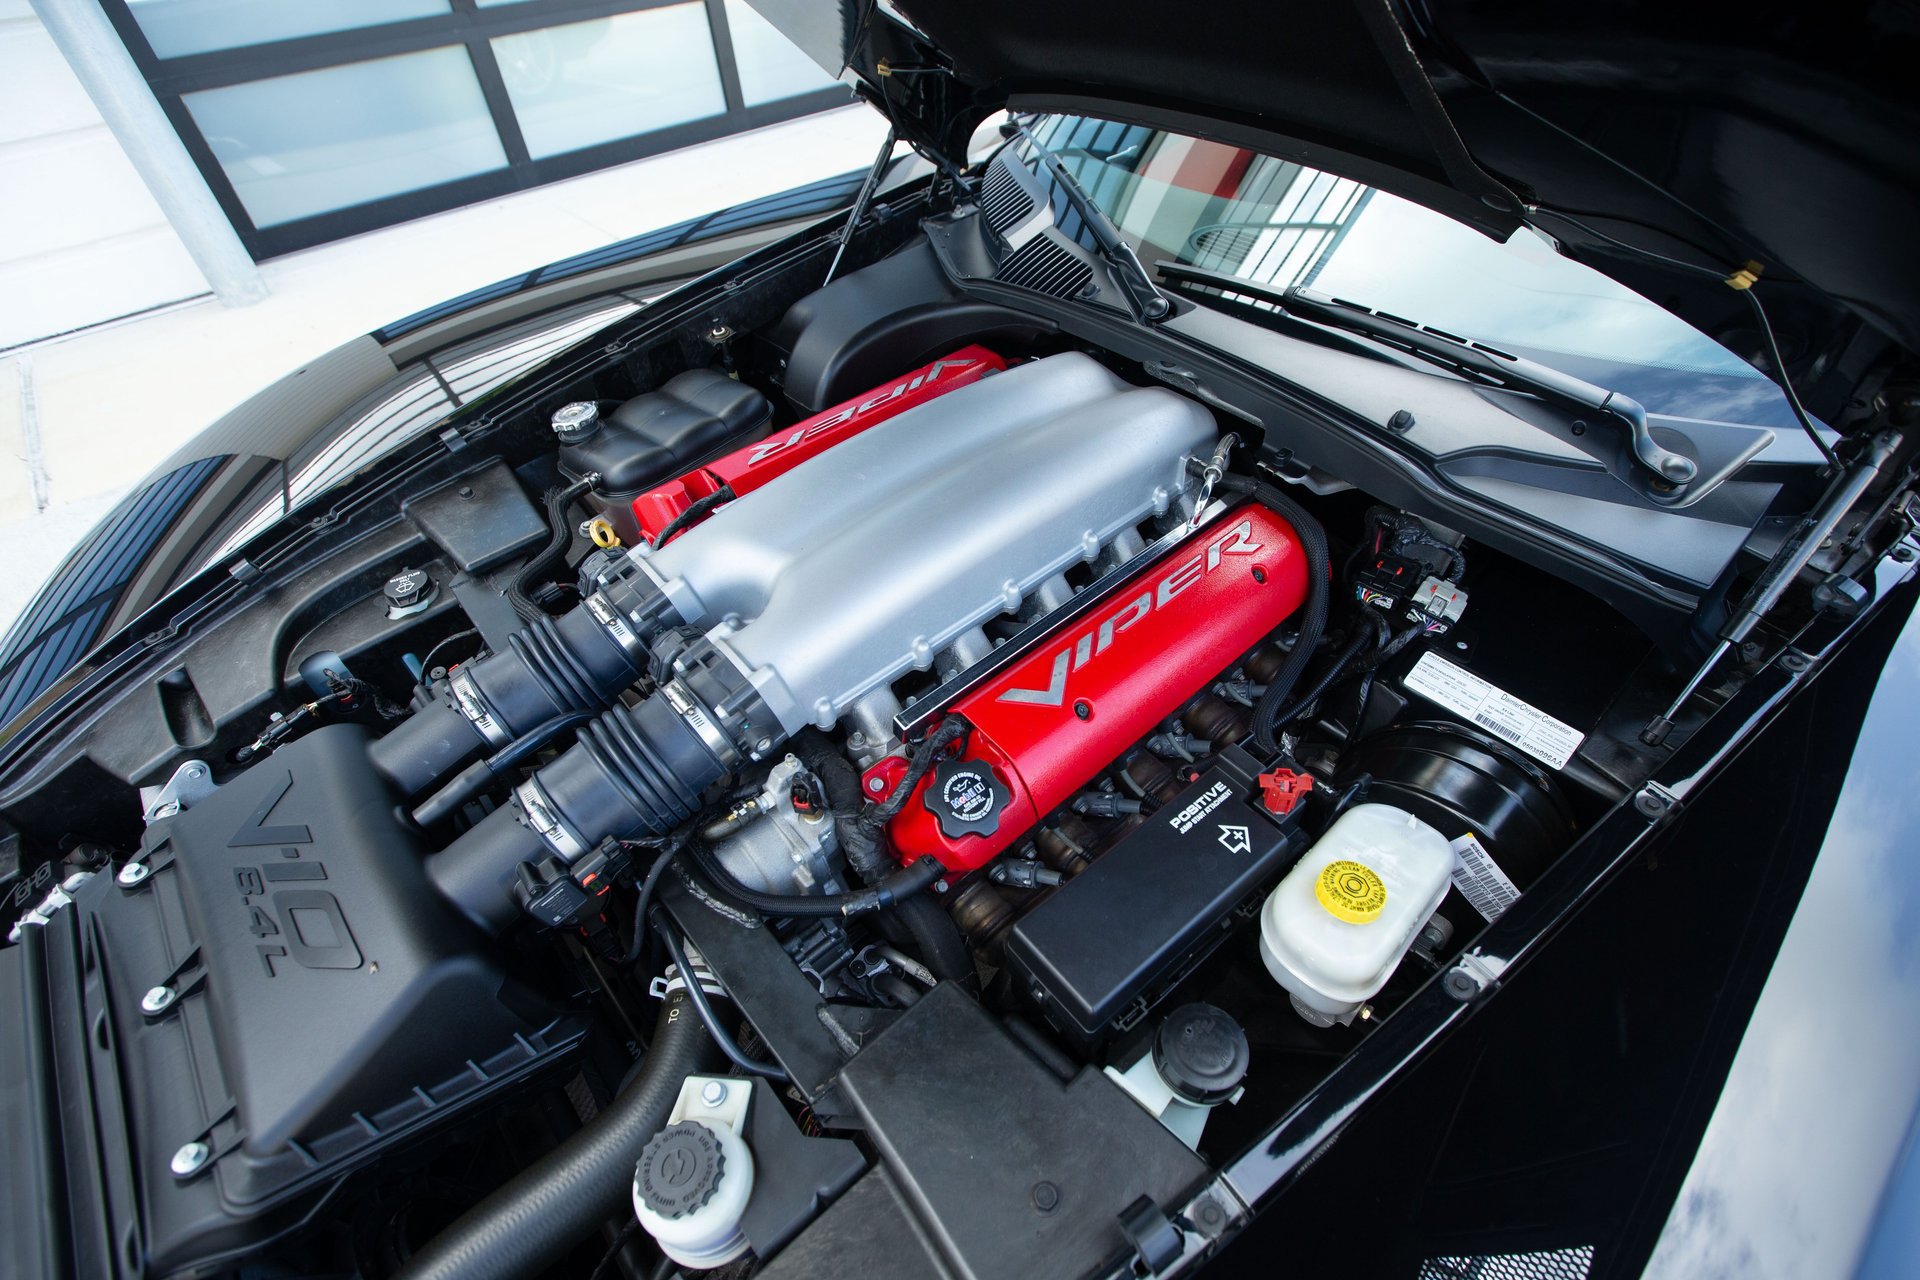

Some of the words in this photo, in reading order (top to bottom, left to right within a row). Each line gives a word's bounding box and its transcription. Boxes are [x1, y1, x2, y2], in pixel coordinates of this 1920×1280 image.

[748, 359, 977, 466] VIPER
[995, 519, 1264, 707] VIPER
[1500, 693, 1541, 719] DaimlerChrysler
[1541, 715, 1572, 736] Corporation
[950, 787, 977, 809] Mobil
[1169, 781, 1227, 829] POSITIVE
[1179, 822, 1193, 834] JUMP
[1191, 811, 1207, 824] START
[1204, 788, 1233, 815] ATTACHMENT
[1470, 843, 1484, 859] BOSCH
[233, 867, 288, 978] 8.4L
[667, 1008, 680, 1024] TO
[662, 1129, 696, 1142] POWER
[651, 1192, 676, 1207] FLUID
